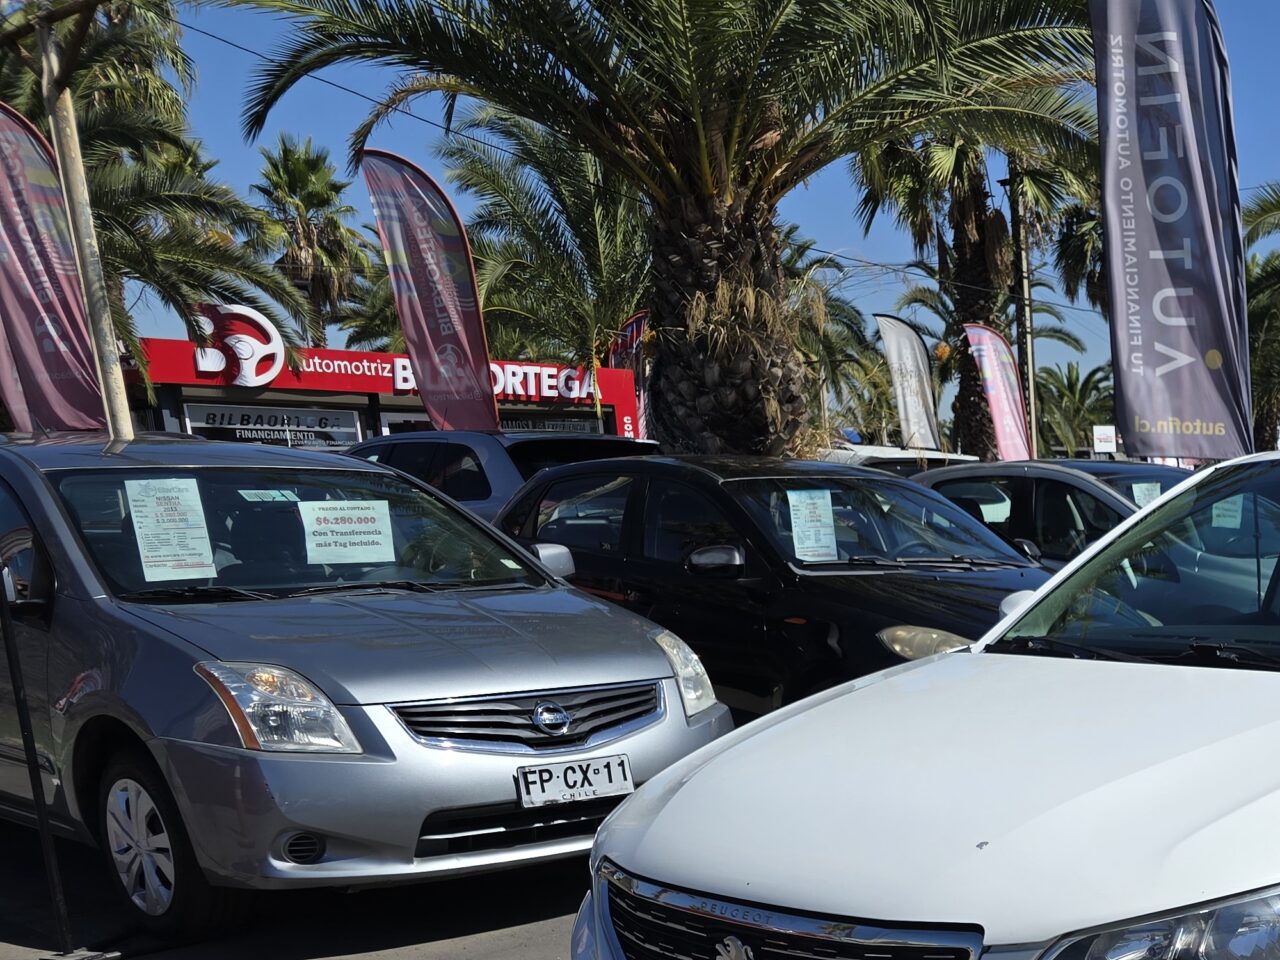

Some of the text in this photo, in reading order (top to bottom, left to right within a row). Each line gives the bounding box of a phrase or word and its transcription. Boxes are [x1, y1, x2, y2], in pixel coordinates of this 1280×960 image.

[315, 516, 376, 526] $6.280.000
[330, 529, 382, 537] Transferencia
[561, 790, 599, 800] CHILE
[700, 901, 774, 924] PEUGEOT
